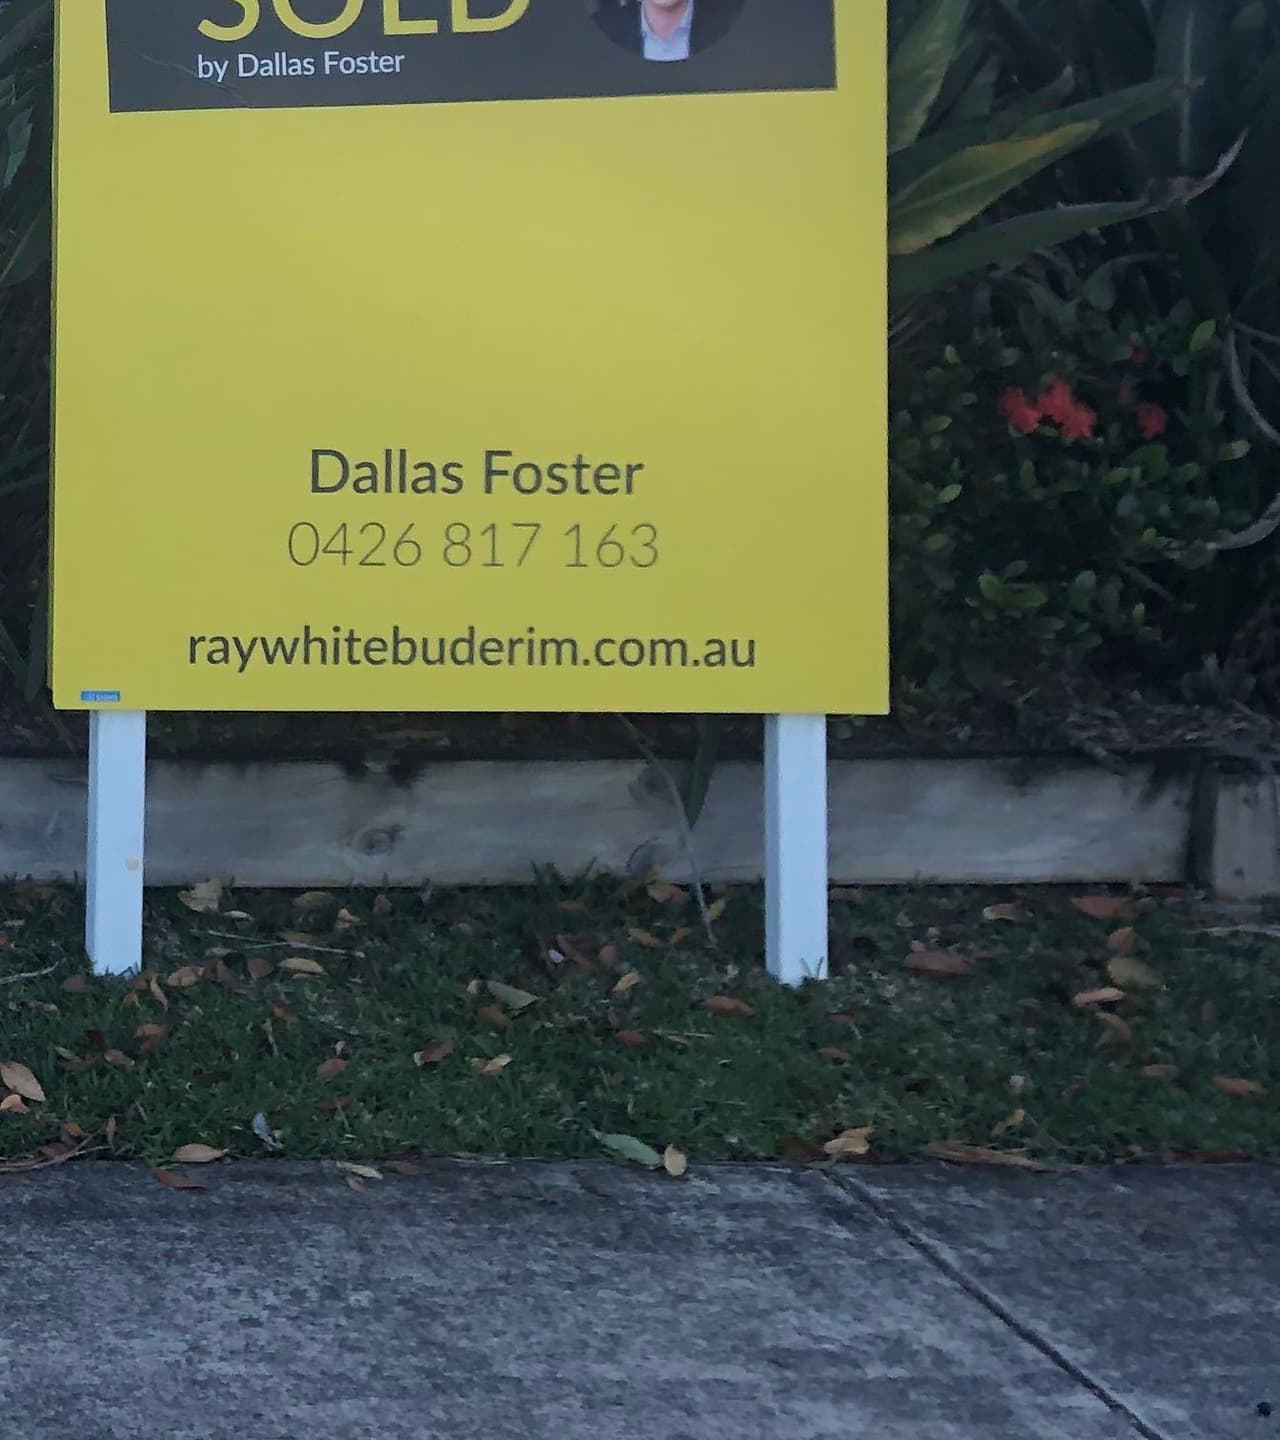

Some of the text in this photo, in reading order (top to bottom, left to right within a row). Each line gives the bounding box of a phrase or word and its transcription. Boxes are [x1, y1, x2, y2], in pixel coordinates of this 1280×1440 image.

[198, 50, 406, 83] by Dallas Foster
[311, 448, 645, 496] Dallas Foster
[287, 521, 659, 569] 0426 817 163
[189, 624, 756, 674] raywhitebuderim.com.au
